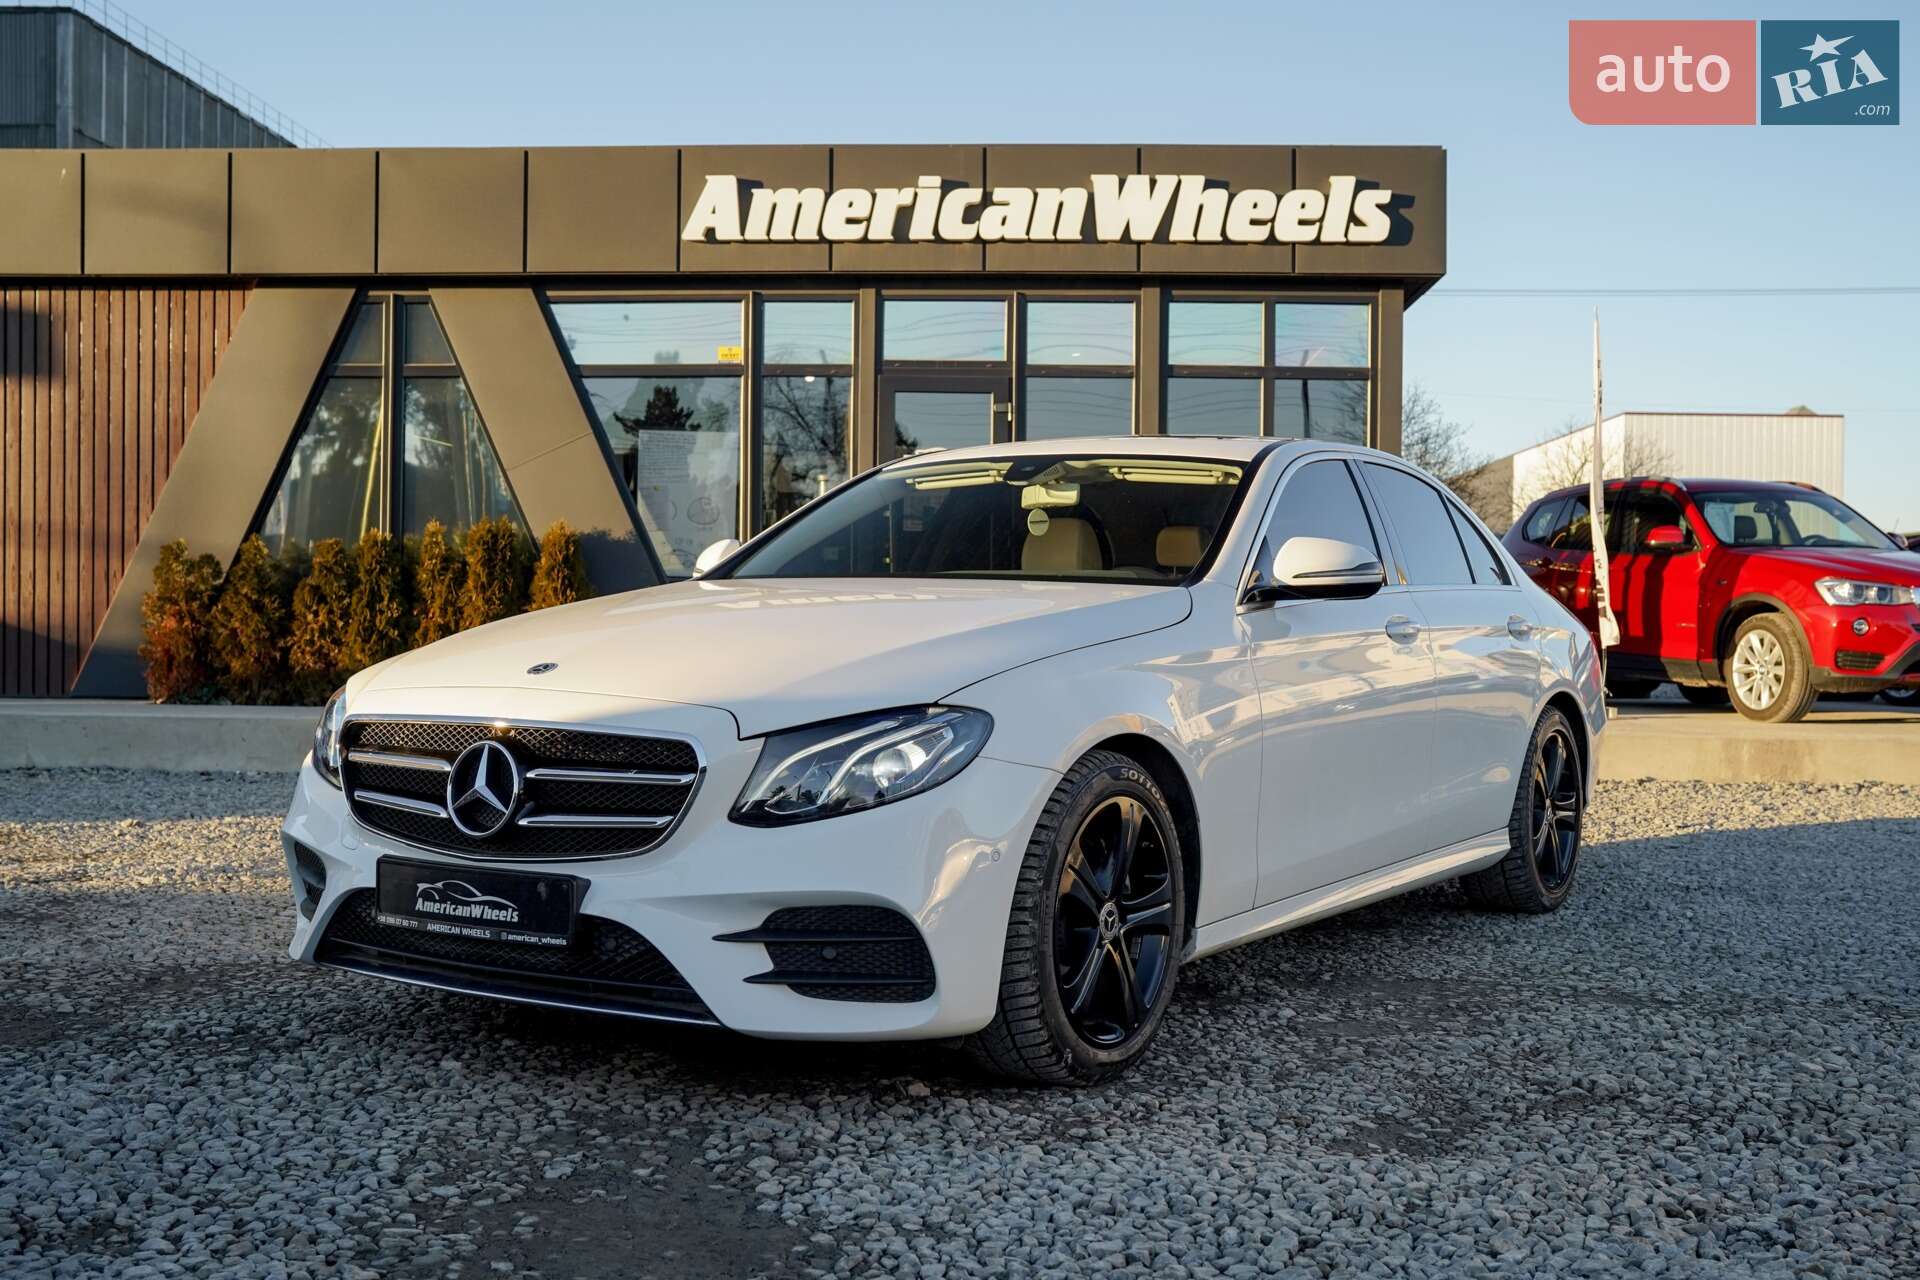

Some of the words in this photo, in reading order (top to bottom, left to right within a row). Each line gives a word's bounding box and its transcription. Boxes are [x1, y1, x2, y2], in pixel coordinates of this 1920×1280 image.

[681, 173, 1393, 244] AmericanWheels
[415, 897, 519, 923] AmericanWheels
[426, 923, 460, 935] AMERICAN
[461, 927, 491, 938] WHEELS
[507, 934, 567, 946] american_wheels
